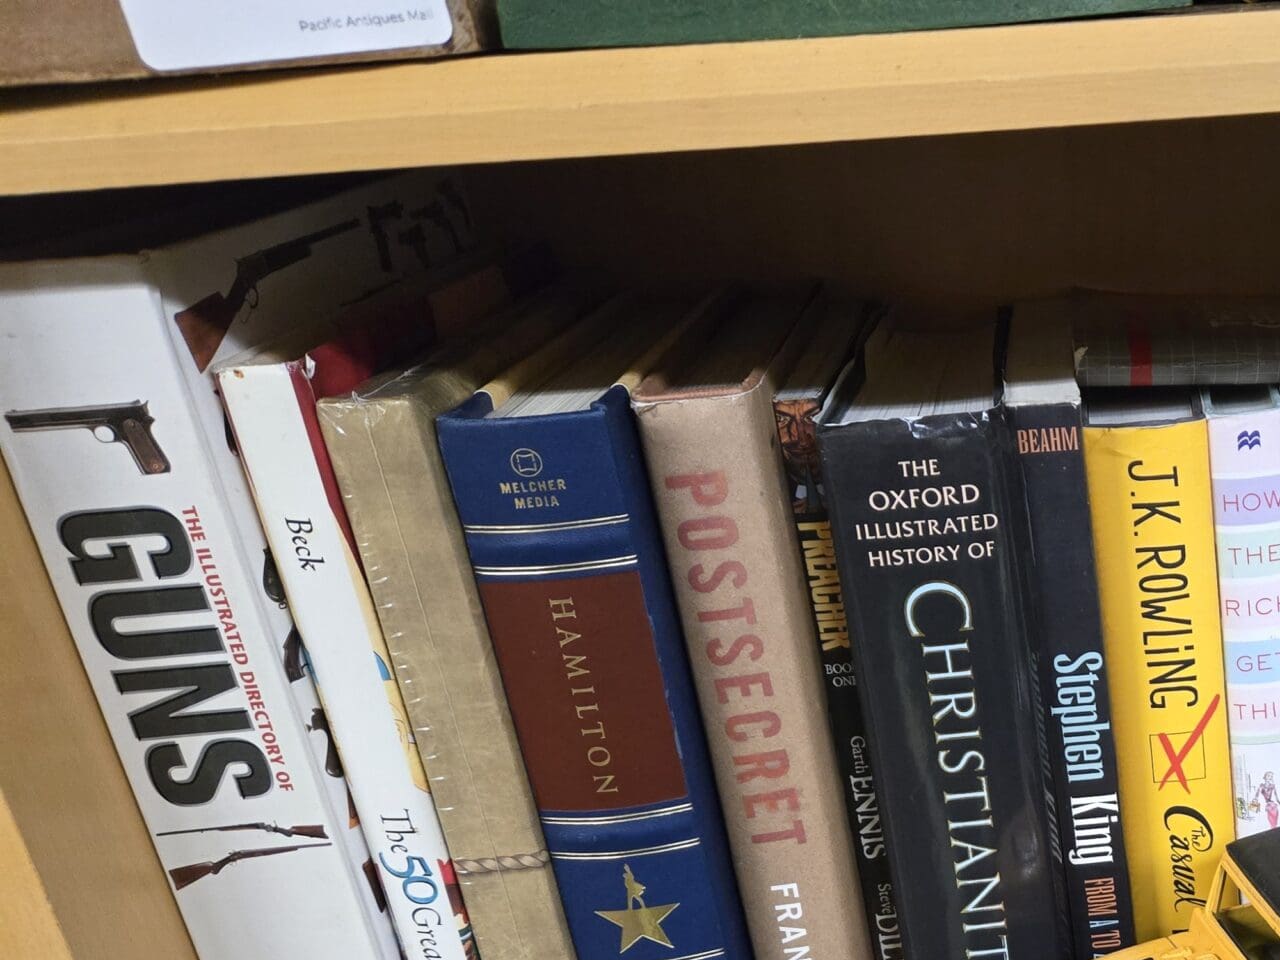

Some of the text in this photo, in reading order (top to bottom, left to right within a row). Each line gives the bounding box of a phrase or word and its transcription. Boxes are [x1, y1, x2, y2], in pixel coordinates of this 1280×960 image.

[1017, 426, 1080, 455] BEAHM
[500, 477, 567, 495] MELCHER
[898, 459, 941, 478] THE
[514, 494, 560, 510] MEDIA
[868, 484, 980, 512] OXFORD
[1128, 460, 1182, 537] J.K.
[285, 515, 325, 571] Beck
[855, 513, 999, 541] ILLUSTRATED
[868, 541, 995, 568] HISTORY OF
[57, 504, 274, 806] GUNS
[182, 505, 295, 793] THE ILLUSTRATED DIRECTORY OF
[665, 471, 807, 846] POSTSECRET
[548, 596, 618, 794] HAMILTON
[1051, 651, 1119, 866] Stephen King
[849, 735, 887, 861] Garth ENNIS
[380, 808, 419, 854] The
[379, 852, 438, 905] 50
[1163, 805, 1214, 912] Casual
[877, 883, 896, 914] Steve
[1084, 877, 1122, 949] FROM A TO
